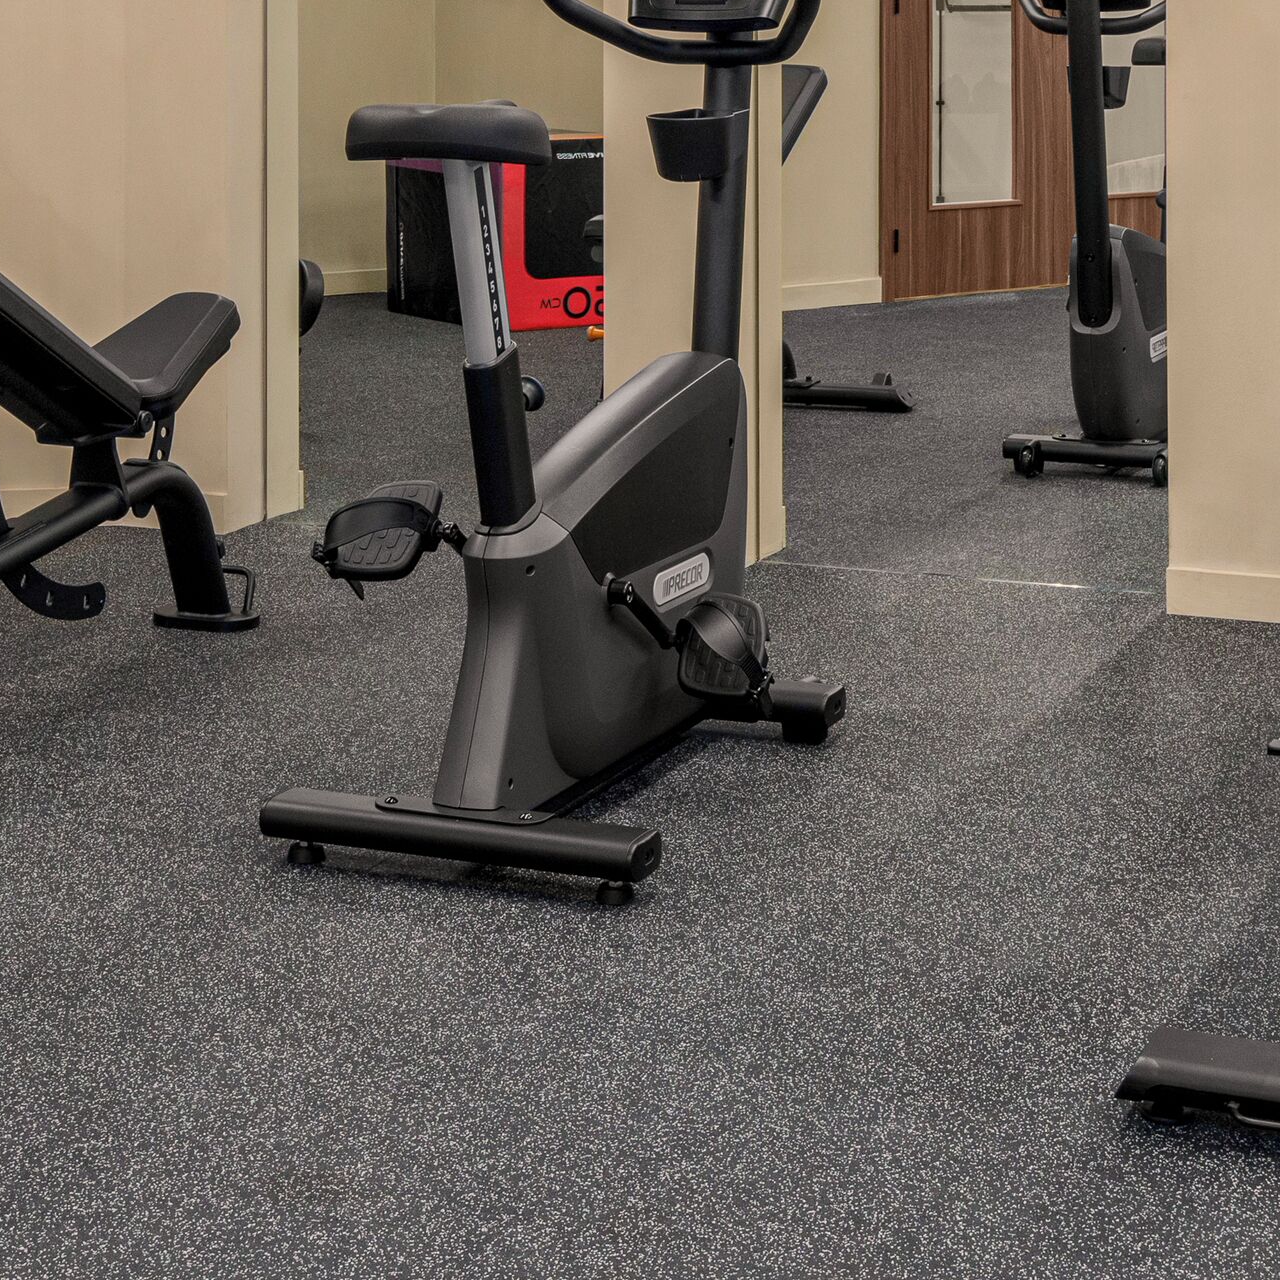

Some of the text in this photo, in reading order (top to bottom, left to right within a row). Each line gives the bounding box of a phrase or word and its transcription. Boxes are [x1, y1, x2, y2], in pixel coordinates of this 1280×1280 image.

[481, 205, 486, 218] 1
[483, 224, 489, 238] 2
[485, 243, 491, 256] 3
[488, 261, 493, 274] 4
[490, 280, 496, 293] 5
[492, 299, 498, 312] 6
[494, 317, 499, 331] 7
[496, 336, 502, 349] 8
[667, 562, 704, 597] PRECOR
